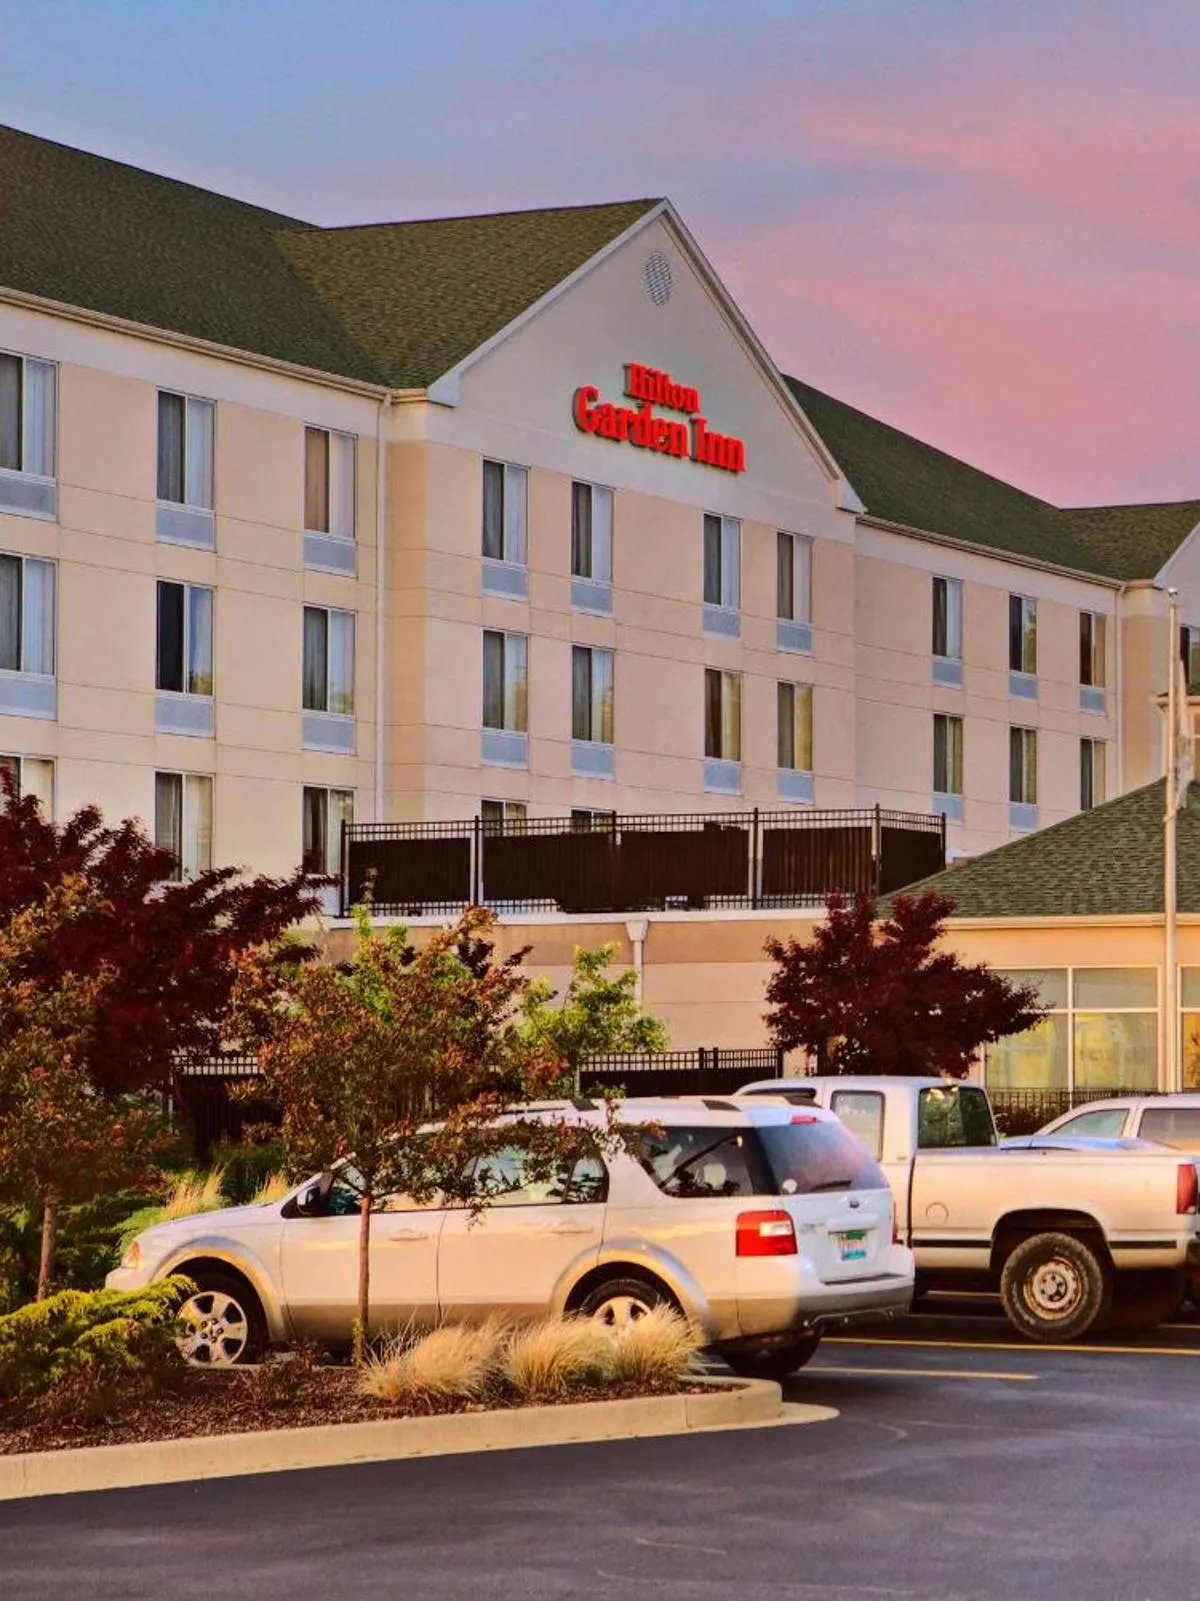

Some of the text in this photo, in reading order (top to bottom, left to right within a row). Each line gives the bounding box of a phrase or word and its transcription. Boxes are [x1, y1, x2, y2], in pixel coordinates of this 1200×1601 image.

[624, 361, 700, 414] Hilton
[573, 384, 746, 474] Garden Inn
